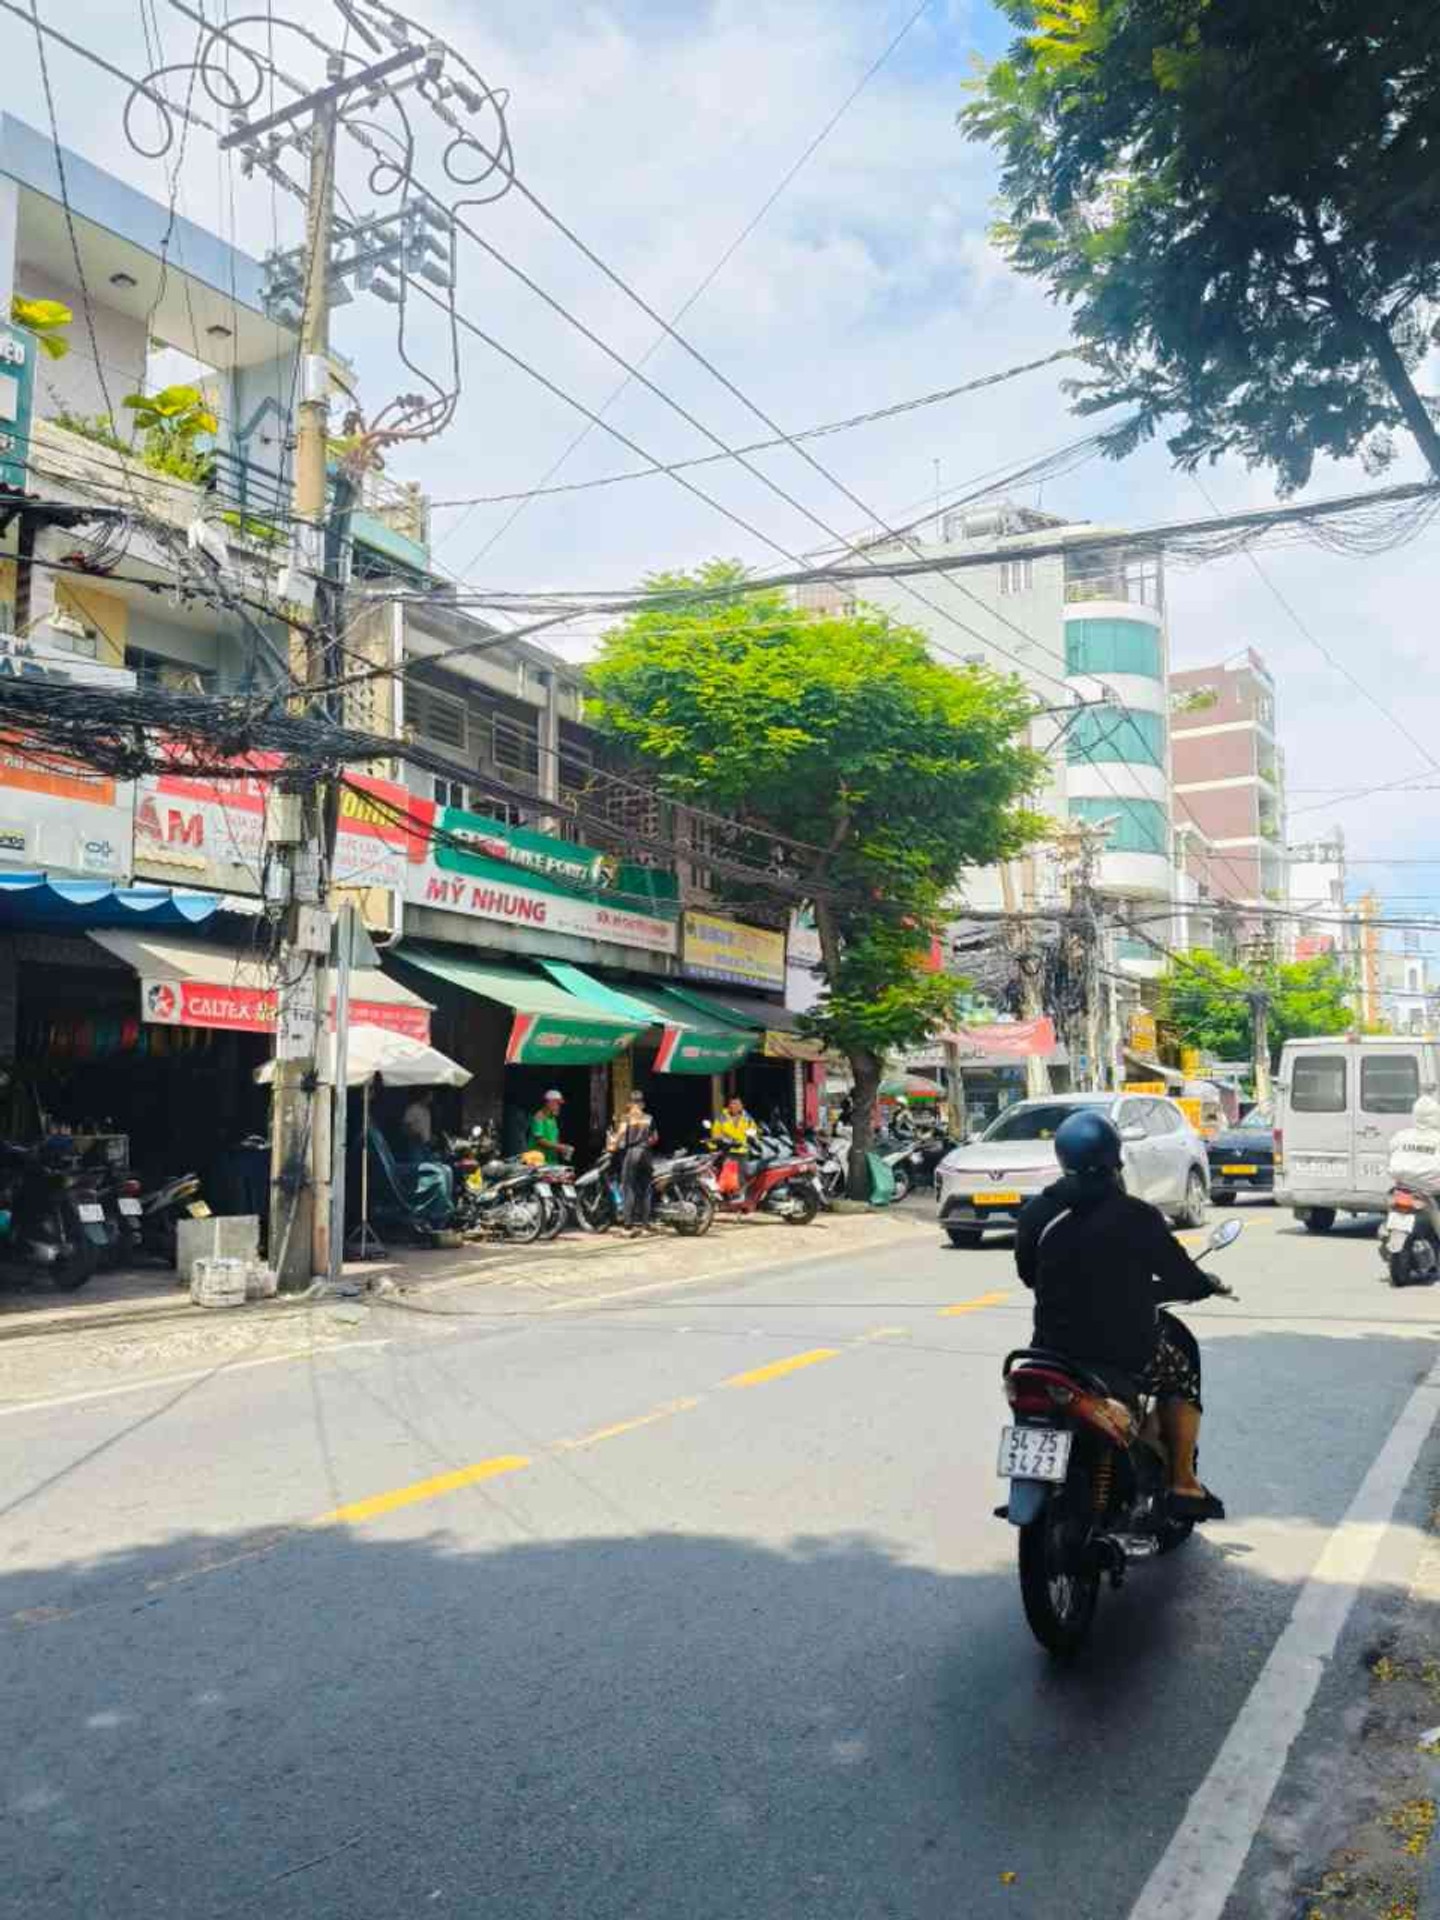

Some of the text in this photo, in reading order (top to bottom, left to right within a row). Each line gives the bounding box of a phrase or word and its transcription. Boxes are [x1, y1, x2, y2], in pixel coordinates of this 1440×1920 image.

[425, 876, 547, 923] MỸ NHUNG
[188, 996, 252, 1020] CALTEX
